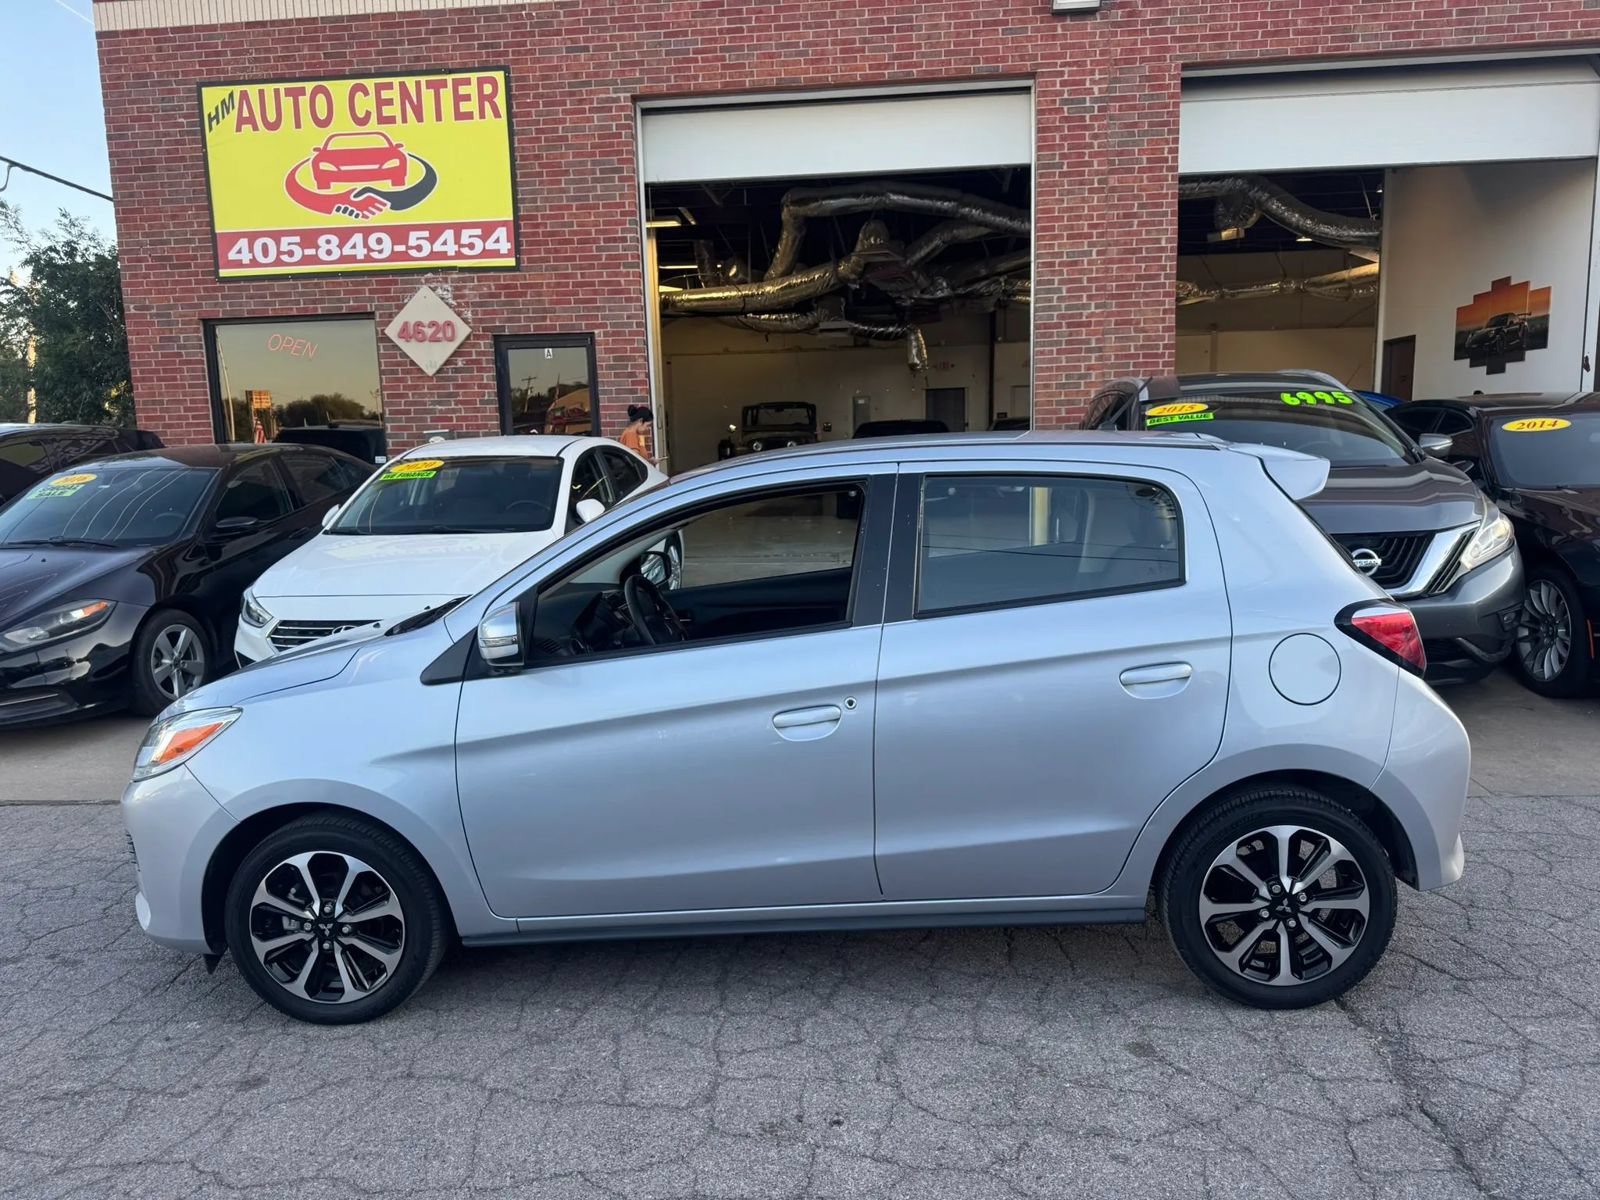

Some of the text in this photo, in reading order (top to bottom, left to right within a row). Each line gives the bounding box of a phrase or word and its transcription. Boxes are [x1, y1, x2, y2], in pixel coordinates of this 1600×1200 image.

[206, 74, 502, 133] HM AUTO CENTER
[227, 226, 512, 265] 405-849-5454
[397, 320, 457, 343] 4620
[268, 333, 319, 359] OPEN
[1280, 391, 1353, 406] 6995
[1157, 404, 1196, 415] 2015
[1148, 416, 1175, 424] BEST
[1515, 419, 1559, 431] 2014
